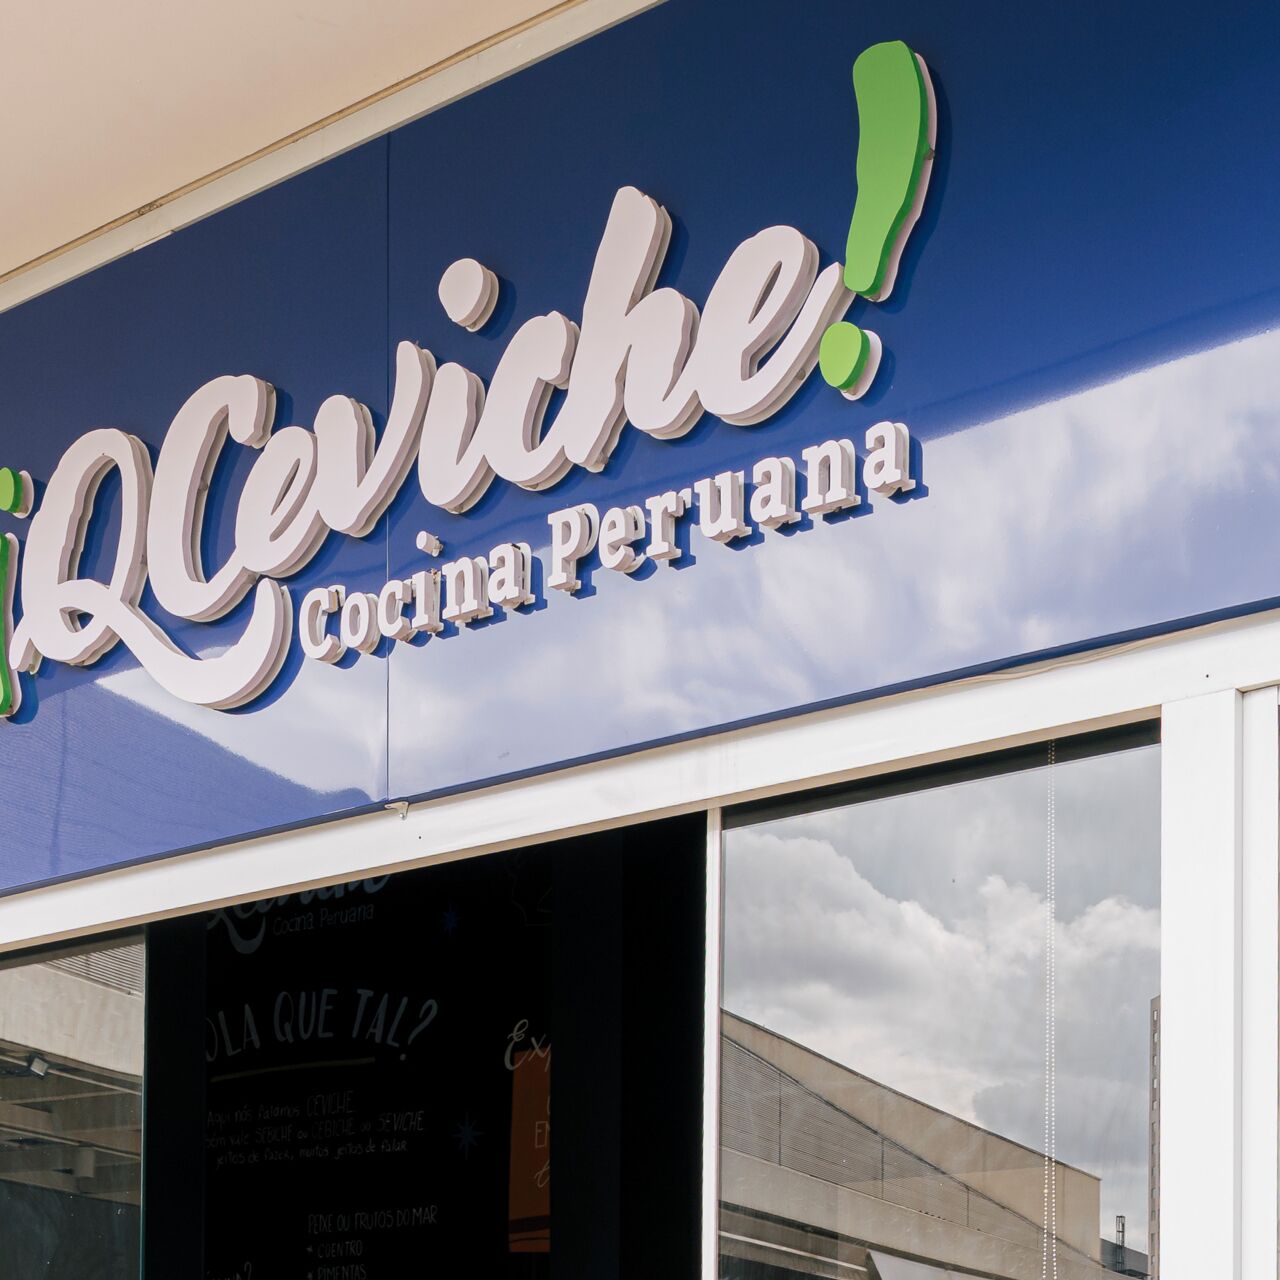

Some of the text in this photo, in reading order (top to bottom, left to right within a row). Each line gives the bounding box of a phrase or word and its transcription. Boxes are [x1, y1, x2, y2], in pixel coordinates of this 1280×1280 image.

[299, 418, 916, 664] Cocina Peruana
[273, 988, 338, 1044] QUE
[351, 988, 439, 1062] TAL?
[307, 1212, 334, 1237] PEIXE
[354, 1210, 394, 1233] FRUTOS
[396, 1208, 410, 1228] DO
[411, 1204, 439, 1228] MAR
[317, 1239, 364, 1260] COENTRO
